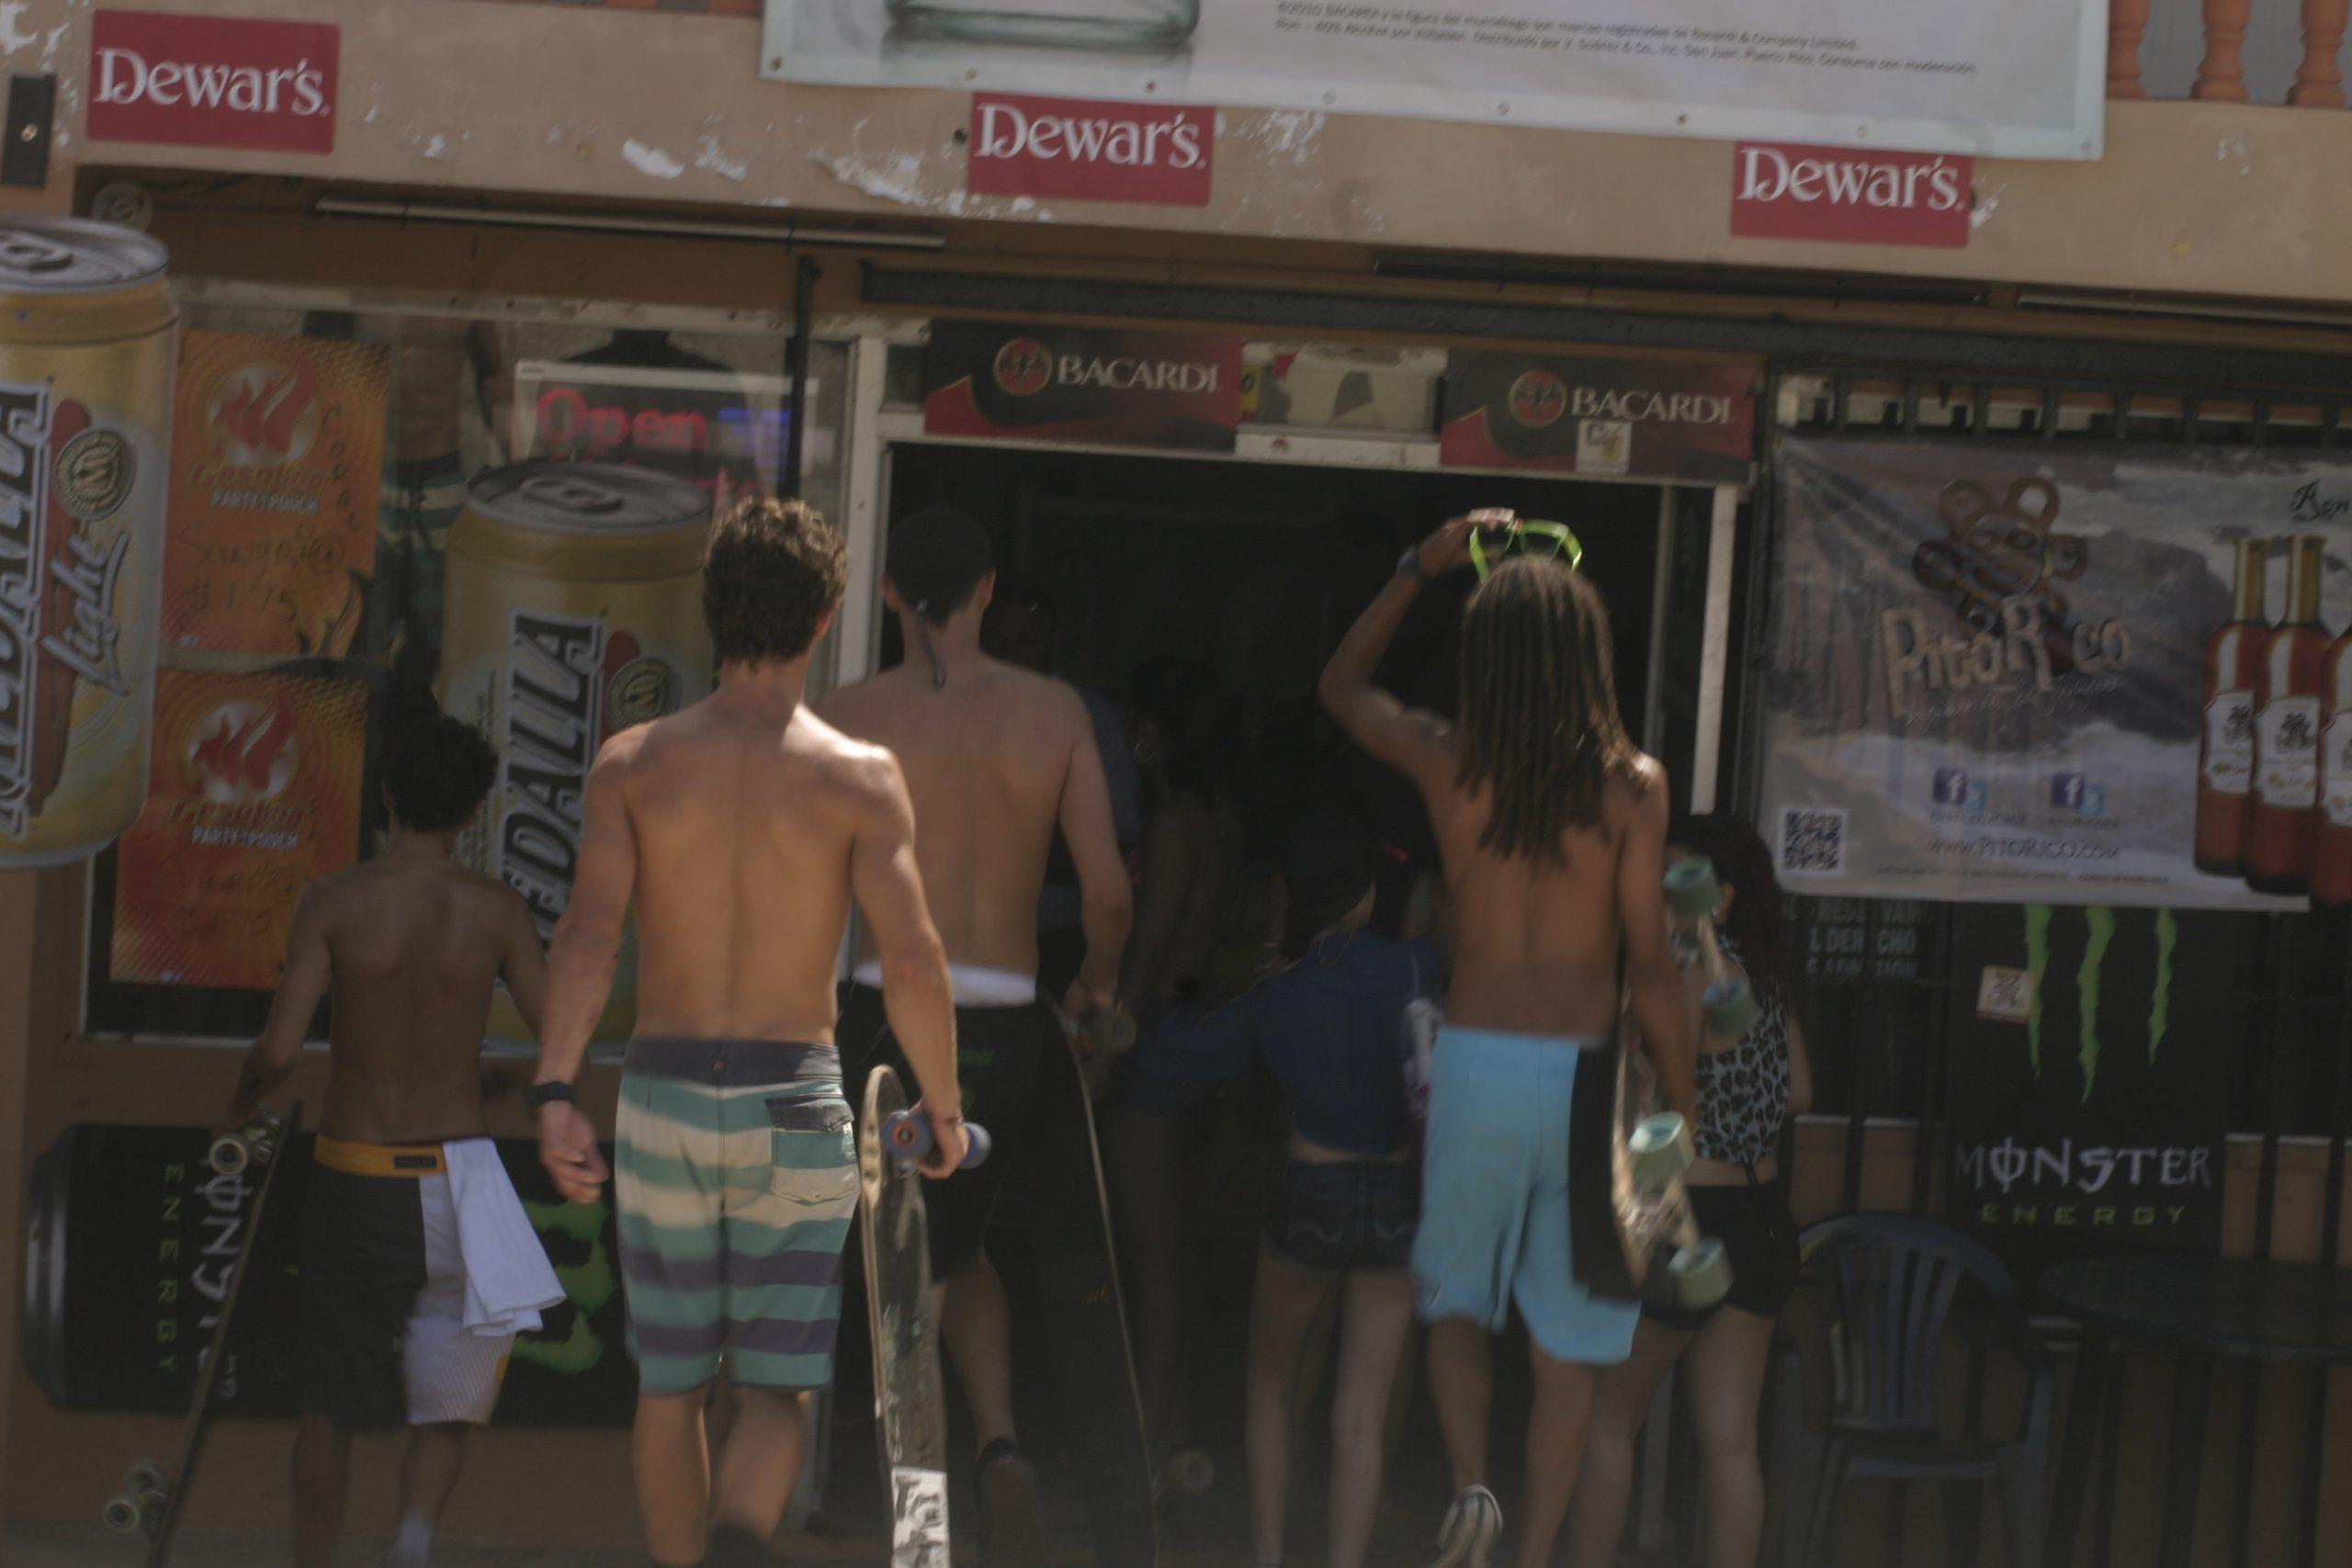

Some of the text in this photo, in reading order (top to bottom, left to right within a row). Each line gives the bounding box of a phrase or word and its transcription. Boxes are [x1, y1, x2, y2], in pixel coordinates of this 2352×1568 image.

[94, 46, 329, 117] Dewar's
[973, 102, 1205, 169] Dewar's
[1736, 145, 1964, 212] Dewar's
[1057, 354, 1219, 394] BACARDI
[1571, 385, 1732, 424] BACARDI
[537, 387, 709, 455] Open
[42, 528, 130, 698] Light
[1880, 595, 2133, 721] PitoRco
[1826, 925, 1917, 956] DERCHO
[1954, 1136, 2213, 1194] MONSTER
[1980, 1202, 2189, 1228] ENERGY
[157, 1162, 187, 1374] ENERGY
